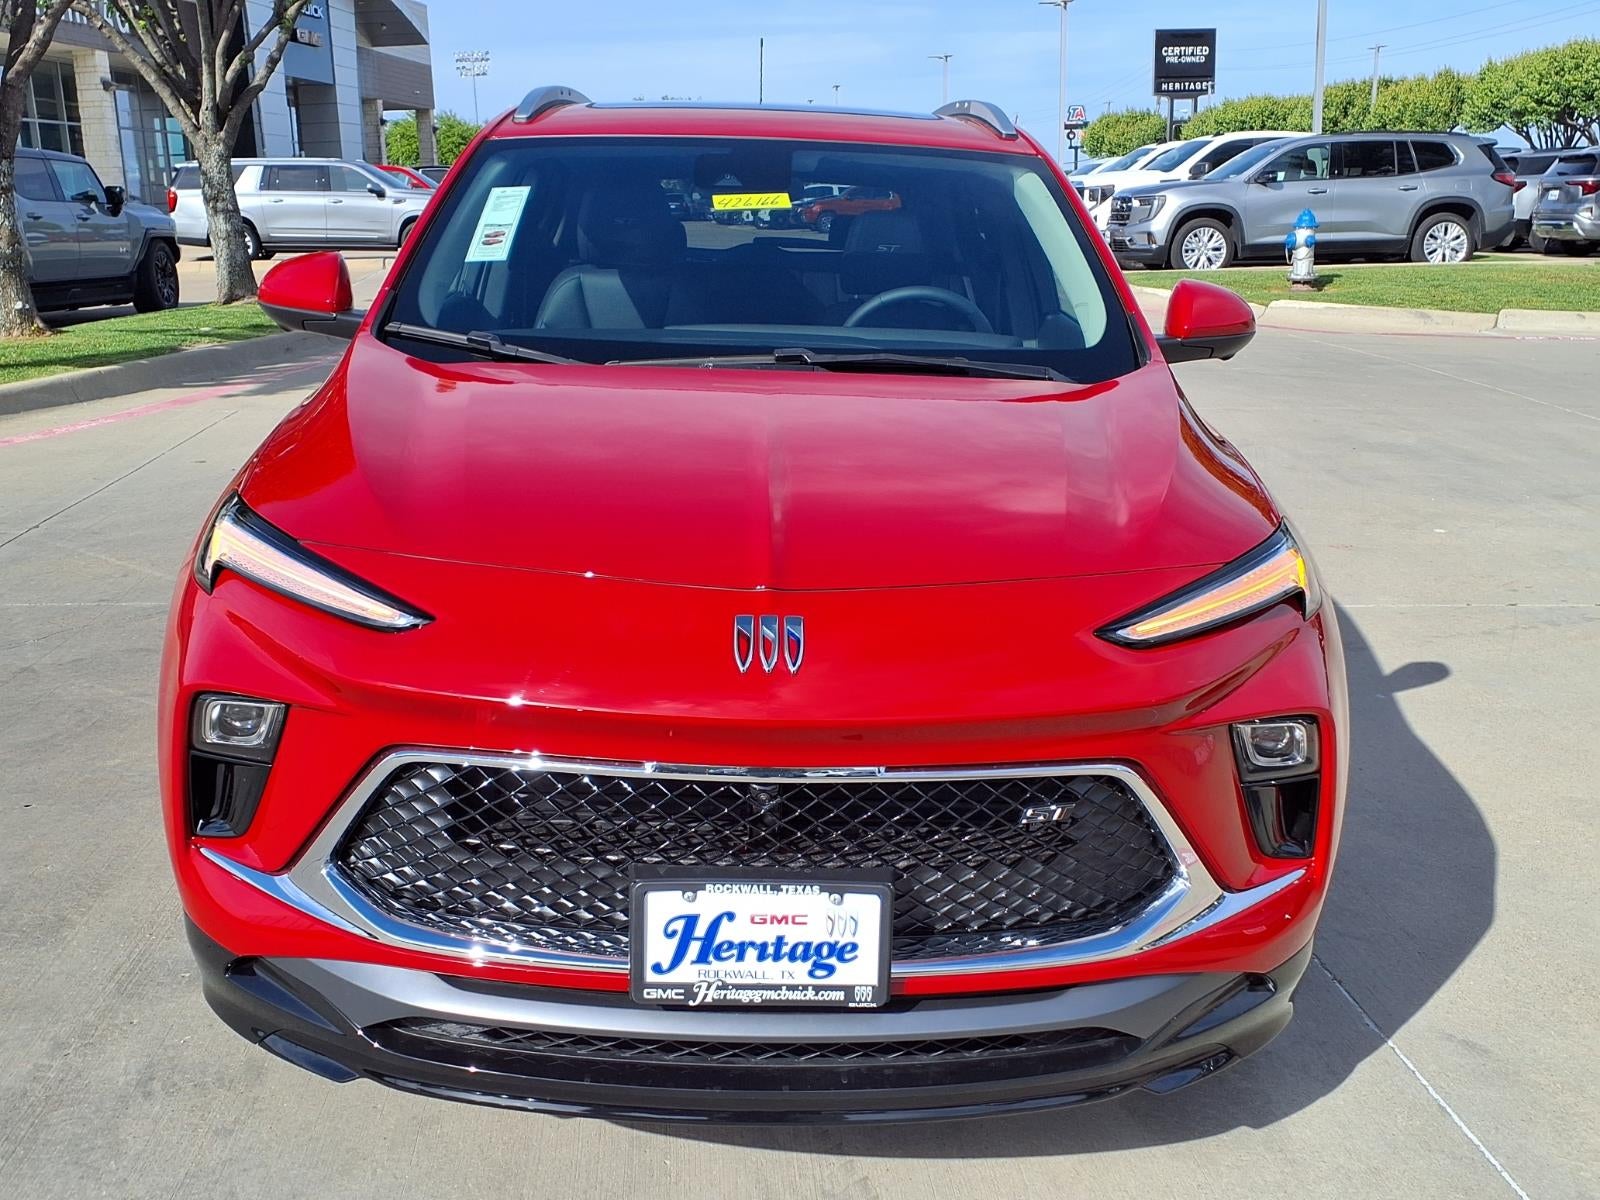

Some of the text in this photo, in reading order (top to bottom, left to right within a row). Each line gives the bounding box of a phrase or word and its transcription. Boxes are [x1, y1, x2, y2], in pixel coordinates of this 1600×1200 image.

[1162, 46, 1209, 56] CERTIFIED
[1165, 55, 1205, 63] PRE-OWNED
[1161, 82, 1208, 91] HERITAGE
[1069, 106, 1085, 120] TA
[717, 195, 781, 208] 426166
[1020, 803, 1076, 824] ST
[705, 883, 821, 896] ROCKWALL, TEXAS
[750, 914, 809, 926] GMC
[650, 911, 860, 980] Heritage
[781, 970, 795, 980] TX
[643, 988, 685, 1000] GMC
[688, 979, 846, 1006] Heritagegmcbuick.com
